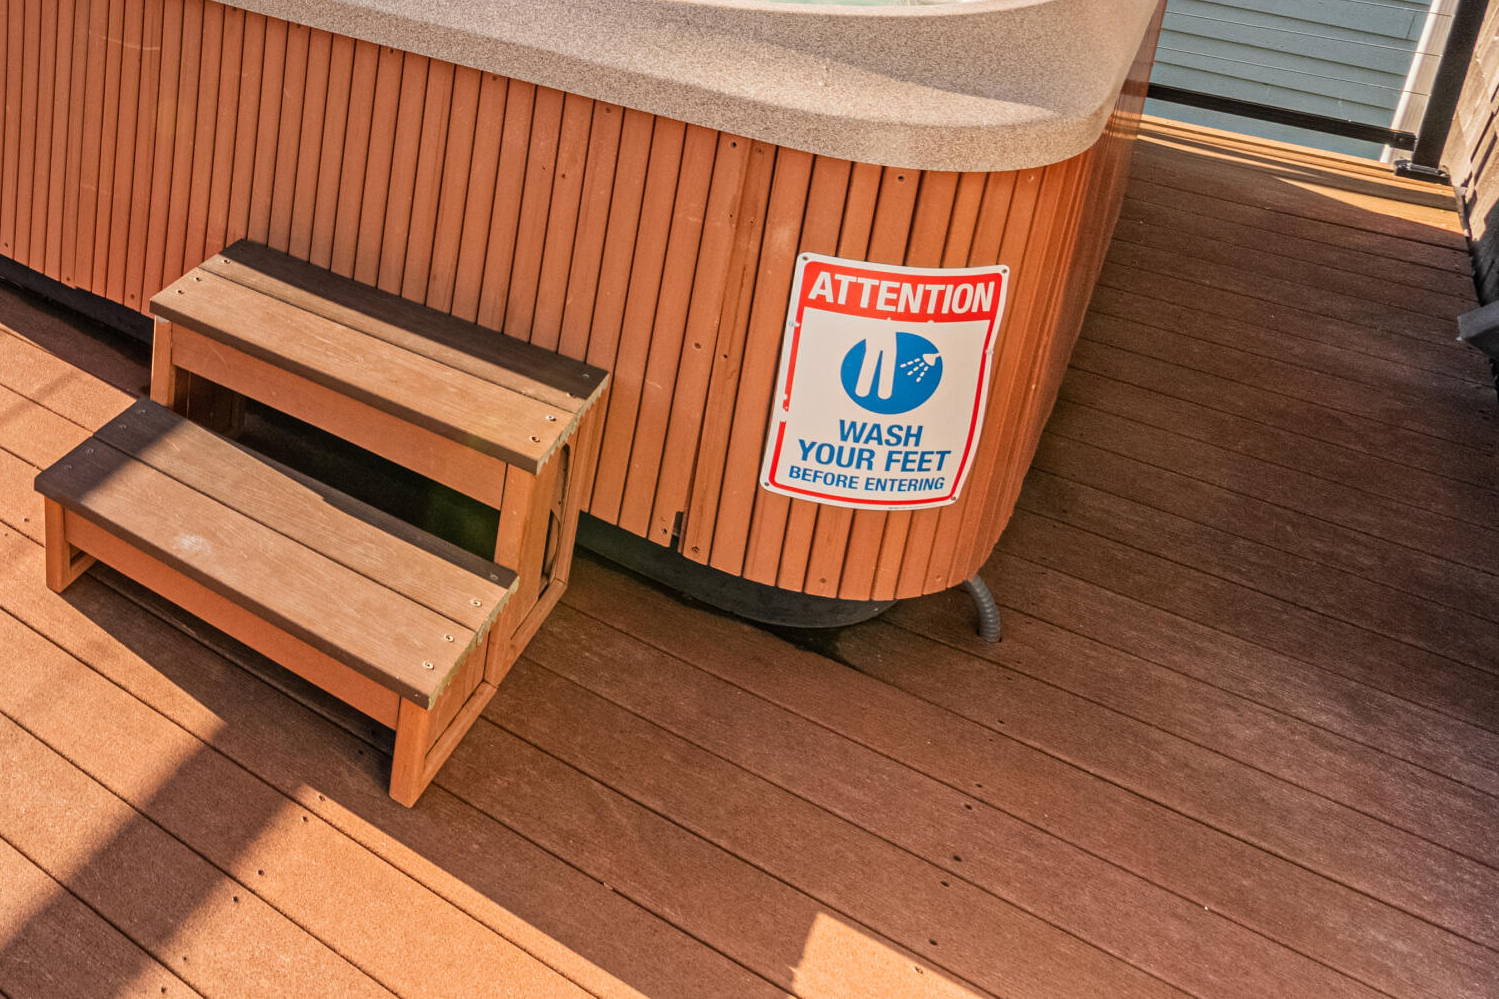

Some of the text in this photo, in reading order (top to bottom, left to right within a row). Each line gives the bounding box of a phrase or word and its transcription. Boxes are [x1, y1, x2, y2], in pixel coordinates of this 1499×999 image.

[808, 271, 995, 314] ATTENTION
[838, 419, 923, 447] WASH
[798, 439, 952, 473] YOUR FEET
[788, 465, 946, 492] BEFORE ENTERING
